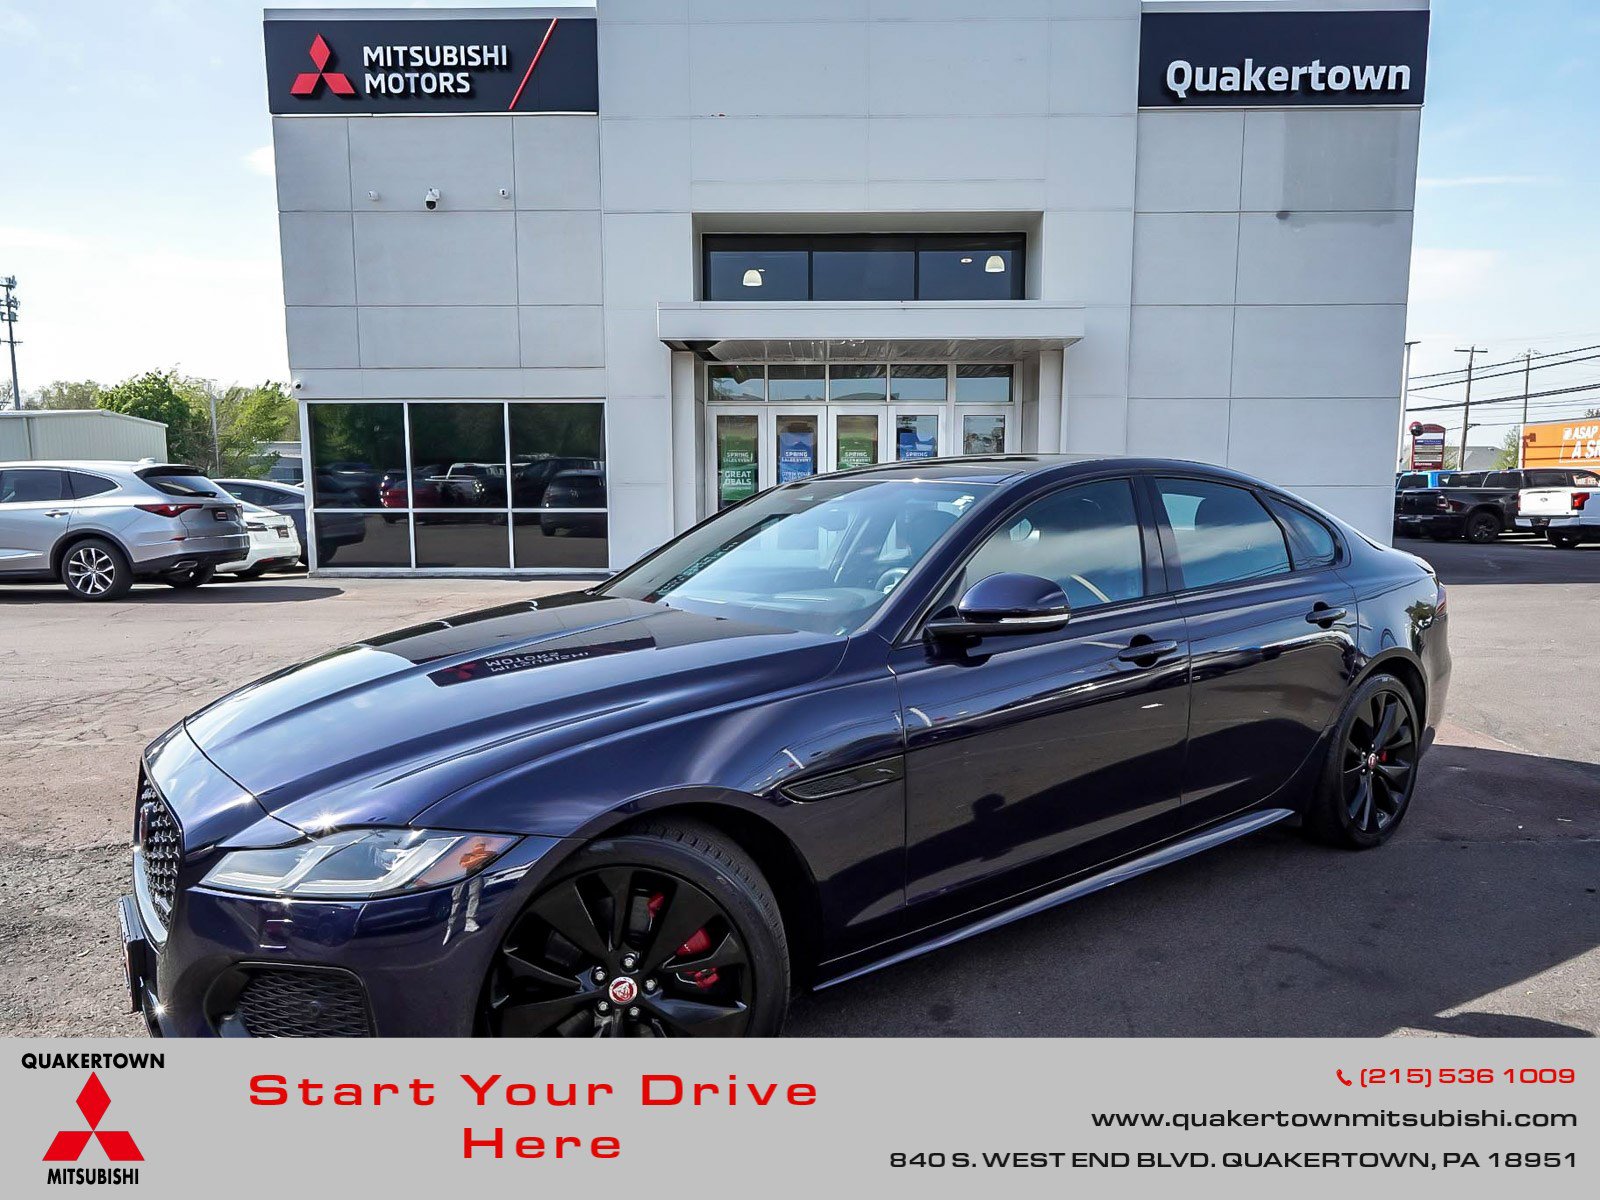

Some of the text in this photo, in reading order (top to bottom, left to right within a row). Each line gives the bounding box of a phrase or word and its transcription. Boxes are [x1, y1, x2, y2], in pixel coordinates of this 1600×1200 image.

[362, 44, 507, 67] MITSUBISHI
[365, 72, 471, 94] MOTORS
[1165, 58, 1411, 98] Quakertown
[724, 470, 752, 478] GREAT
